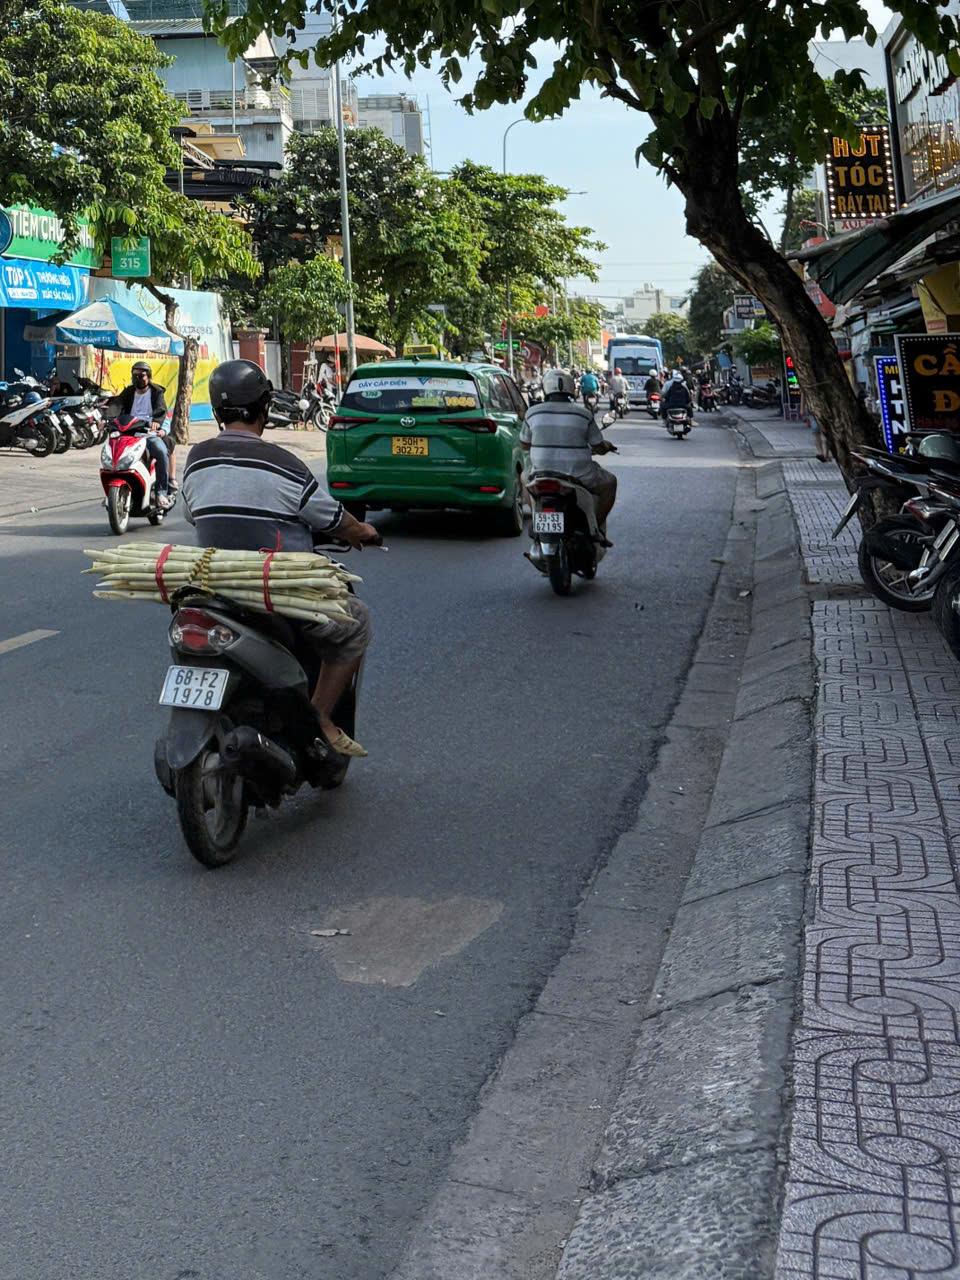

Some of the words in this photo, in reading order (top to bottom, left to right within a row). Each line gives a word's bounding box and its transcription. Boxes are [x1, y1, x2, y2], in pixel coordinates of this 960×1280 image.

[835, 161, 883, 187] TÓC
[837, 192, 864, 213] RÁY
[866, 194, 888, 213] TAI
[120, 257, 141, 269] 315
[173, 687, 214, 706] 1978
